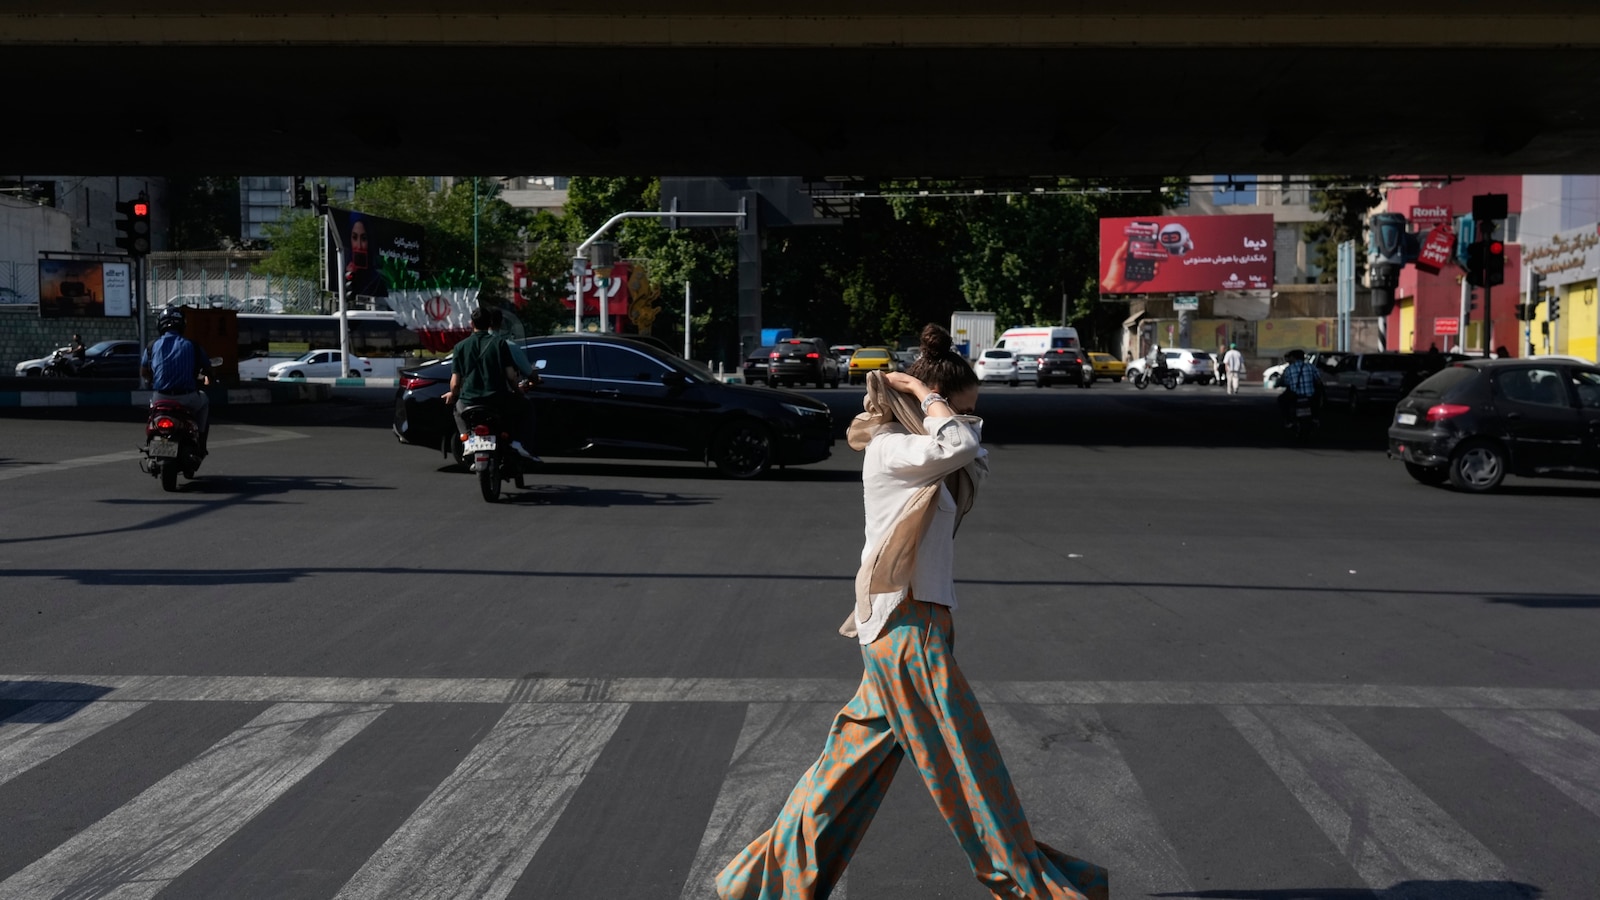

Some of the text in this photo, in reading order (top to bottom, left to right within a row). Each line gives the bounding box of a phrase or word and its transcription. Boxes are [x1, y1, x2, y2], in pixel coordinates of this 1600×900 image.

[1413, 205, 1448, 217] Ronix
[1243, 237, 1267, 251] دیما
[1426, 241, 1449, 253] فروش
[1183, 254, 1267, 266] بانکداری با هوش مصنوعی
